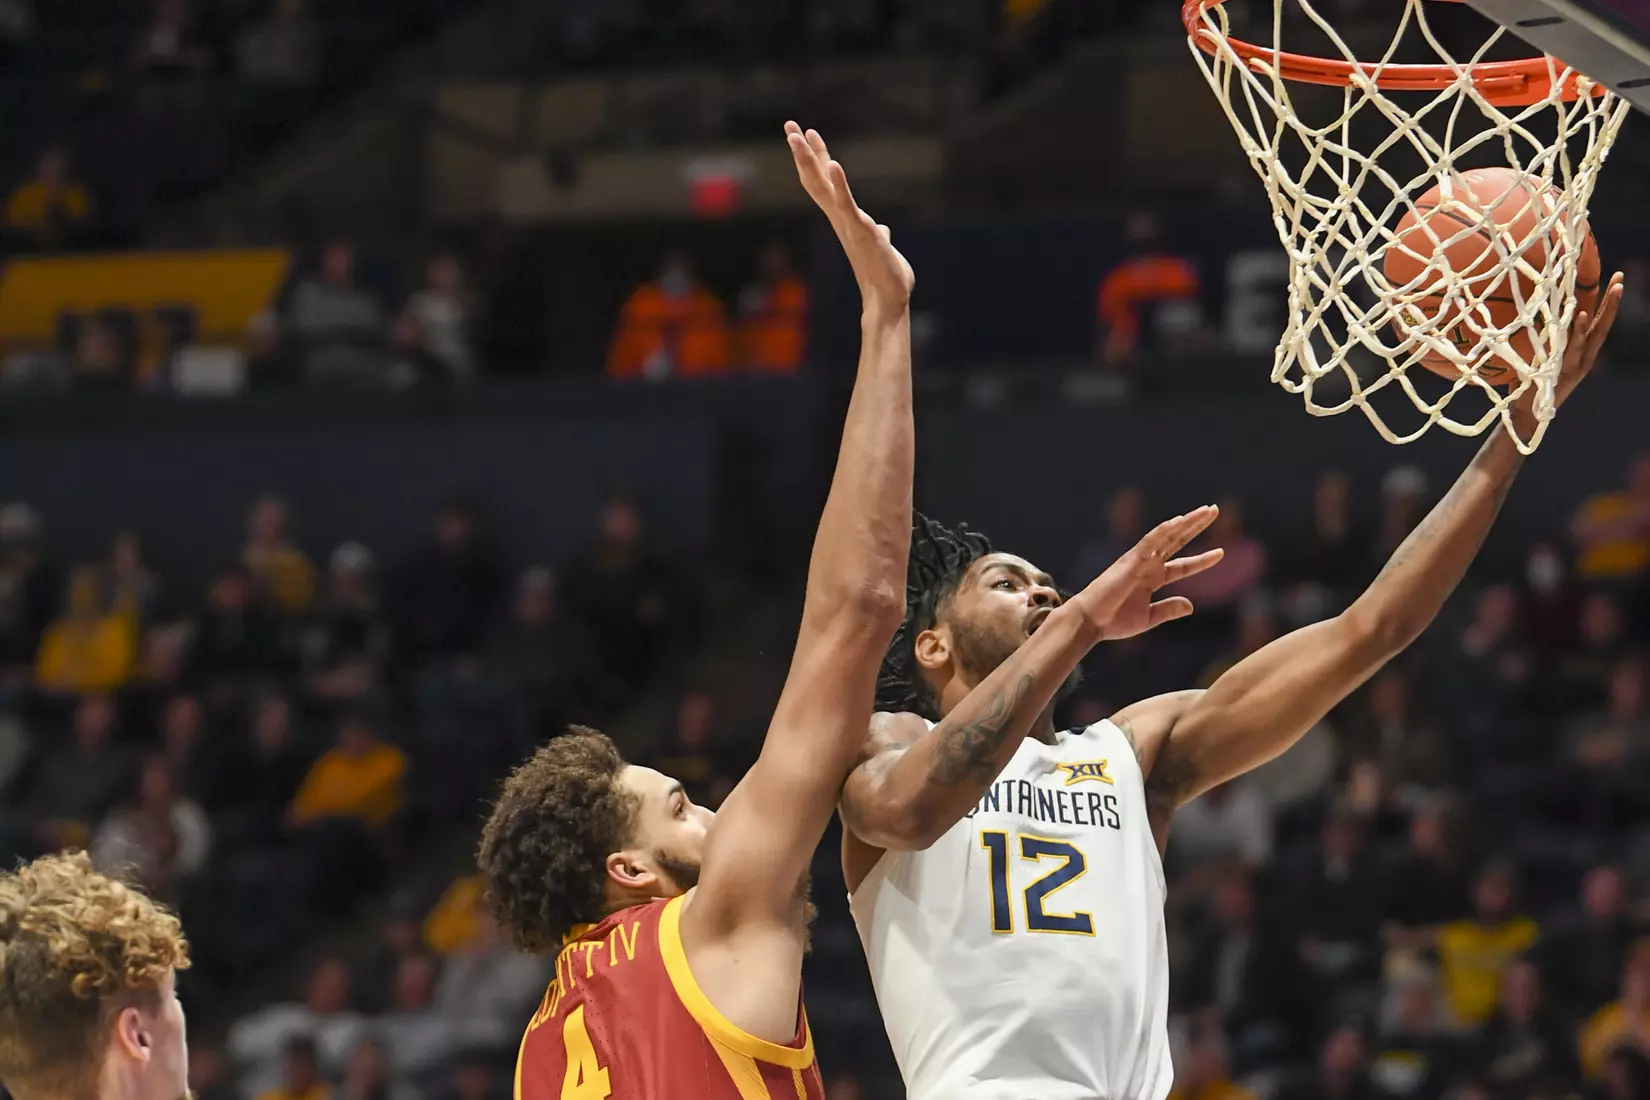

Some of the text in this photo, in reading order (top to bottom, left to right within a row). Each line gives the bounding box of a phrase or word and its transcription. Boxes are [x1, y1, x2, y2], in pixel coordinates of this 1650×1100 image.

[963, 779, 1122, 830] NTAINEERS
[980, 829, 1097, 937] 12
[609, 921, 641, 967] IV
[560, 1004, 612, 1100] 4
